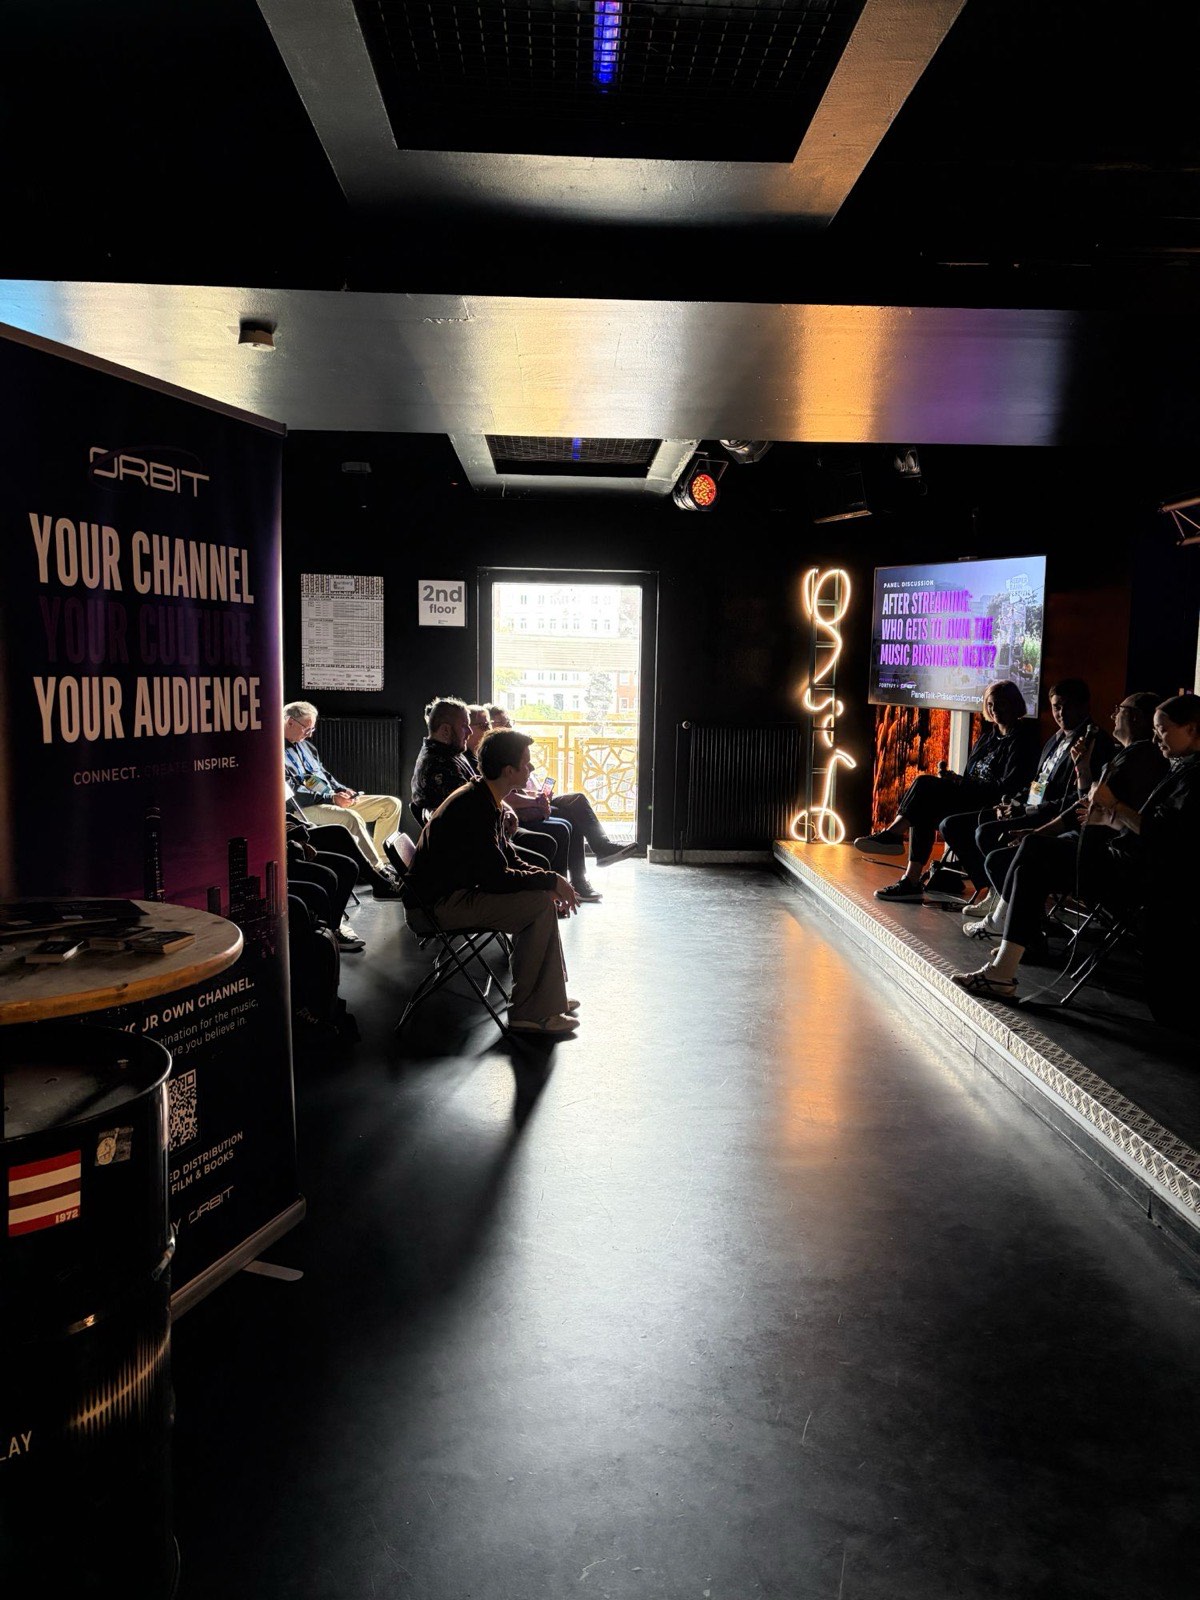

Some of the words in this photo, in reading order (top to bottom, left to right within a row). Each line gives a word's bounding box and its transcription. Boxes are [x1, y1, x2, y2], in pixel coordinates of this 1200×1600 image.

[89, 446, 210, 498] ORBIT
[29, 512, 123, 592] YOUR
[131, 530, 255, 605] CHANNEL
[422, 584, 463, 603] 2nd
[883, 581, 900, 589] PANEL
[901, 579, 934, 588] DISCUSSION
[429, 603, 457, 615] floor
[882, 592, 910, 615] AFTER
[38, 595, 129, 667] YOUR
[138, 602, 255, 667] CULTURE
[881, 618, 904, 641] WHO
[905, 617, 929, 641] GETS
[930, 617, 943, 641] TO
[945, 617, 971, 641] OWN
[974, 615, 994, 641] THE
[880, 643, 910, 666] MUSIC
[911, 644, 960, 668] BUSINESS
[33, 675, 126, 744] YOUR
[133, 676, 262, 738] AUDIENCE
[73, 766, 140, 785] CONNECT.
[193, 756, 240, 772] INSPIRE.
[162, 998, 195, 1023] OWN
[197, 976, 255, 1008] CHANNEL.
[199, 1017, 213, 1030] for
[214, 1011, 230, 1024] the
[186, 1037, 203, 1054] you
[204, 1021, 236, 1043] believe
[182, 1130, 243, 1175] DISTRIBUTION
[171, 1173, 194, 1195] FILM
[195, 1169, 202, 1180] &
[204, 1149, 235, 1175] BOOKS
[55, 1208, 79, 1225] 1972
[188, 1184, 235, 1225] ORBIT
